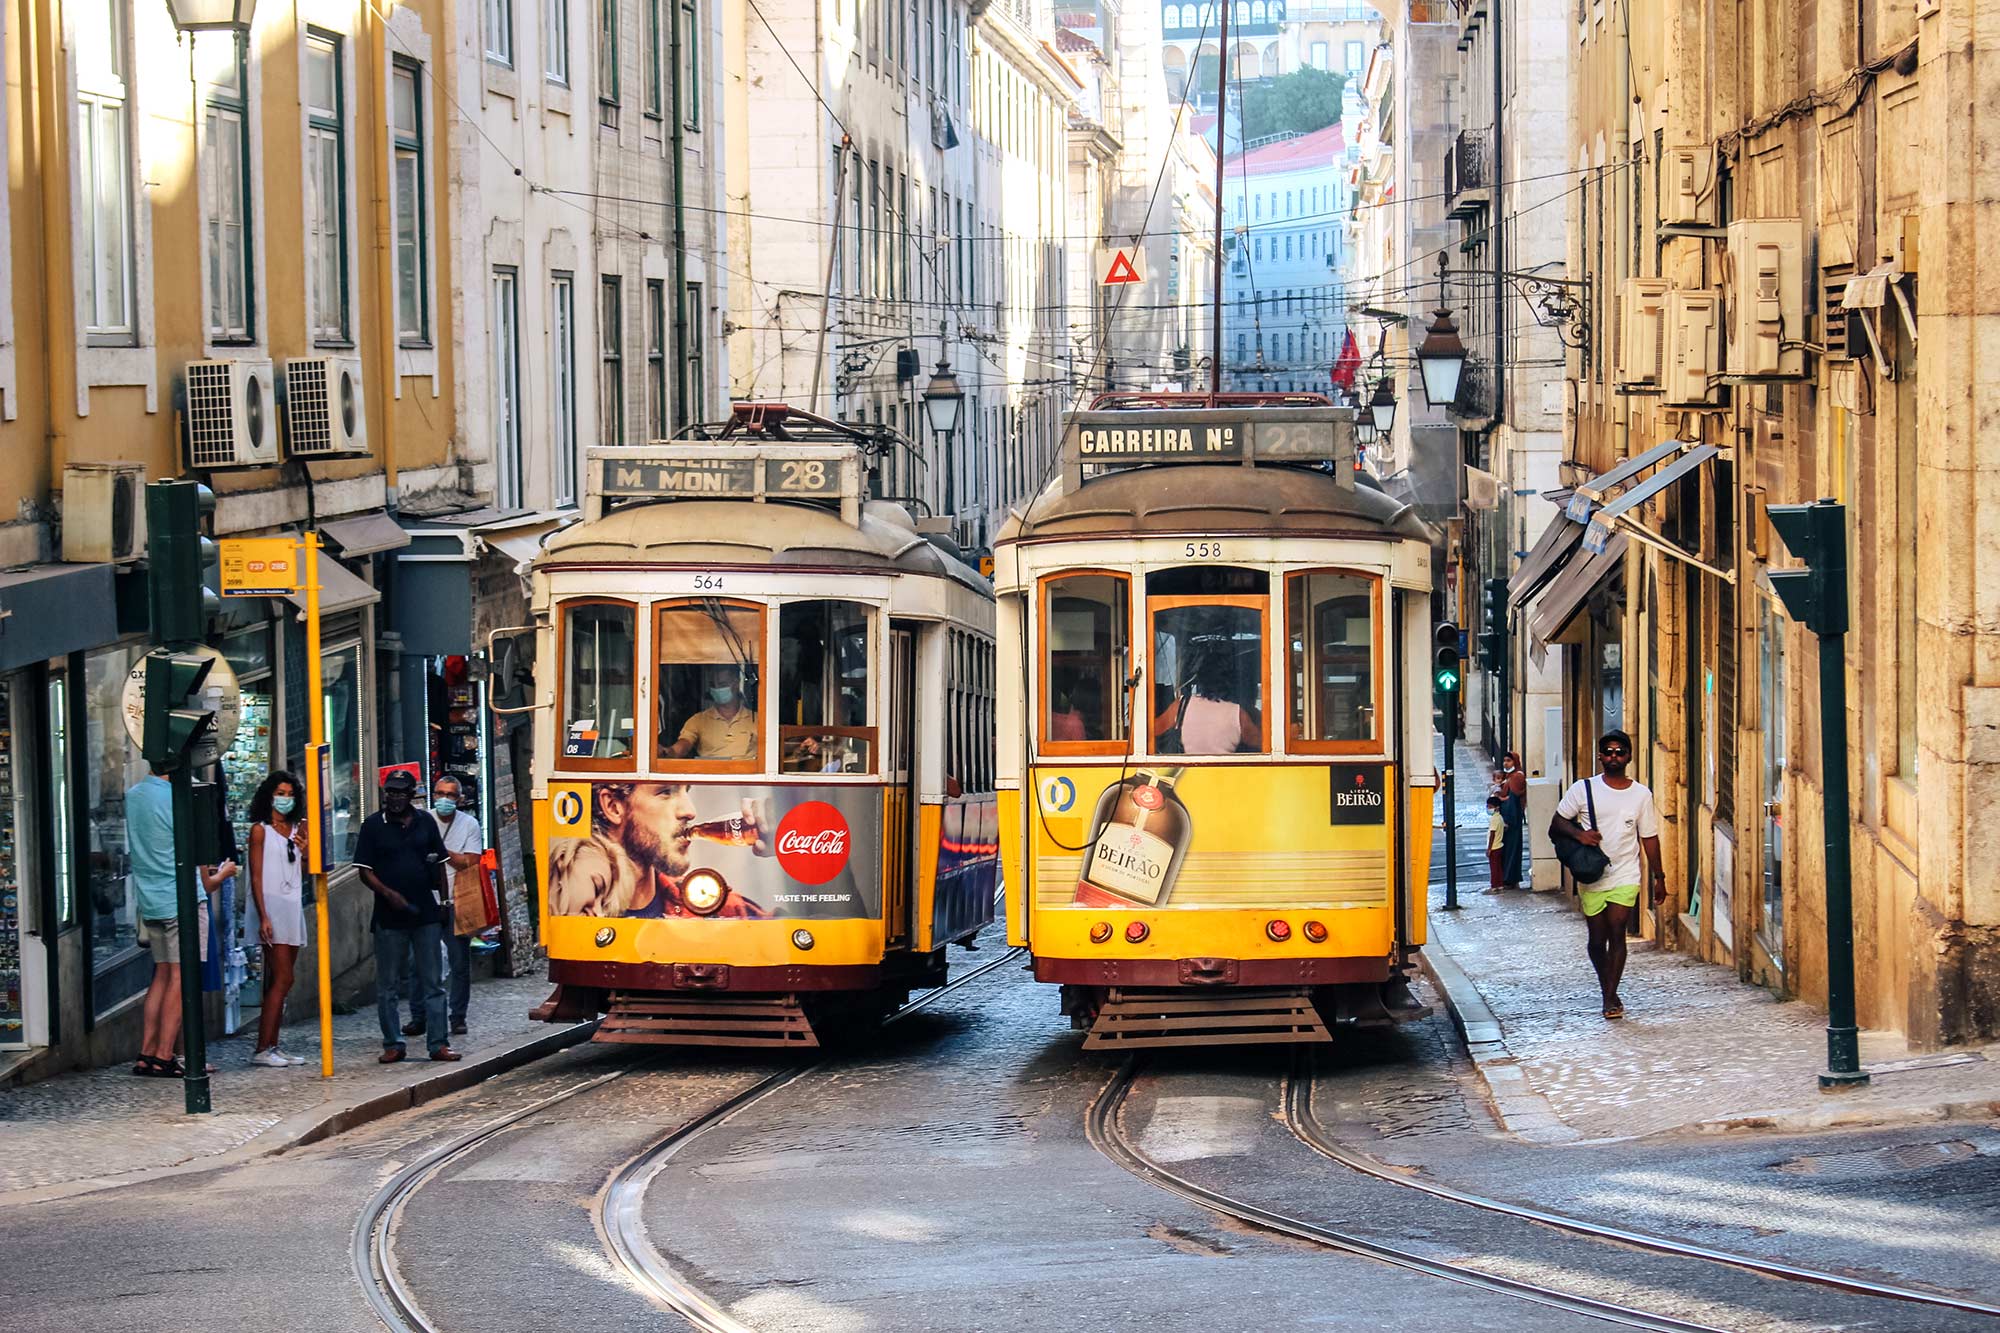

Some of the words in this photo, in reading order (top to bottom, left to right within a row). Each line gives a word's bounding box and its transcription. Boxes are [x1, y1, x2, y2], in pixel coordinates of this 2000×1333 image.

[1080, 428, 1193, 454] CARREIRA
[1207, 428, 1234, 452] Nº
[1264, 427, 1313, 454] 28
[616, 468, 644, 488] M.
[659, 470, 749, 492] MONIZ
[781, 461, 826, 489] 28
[1185, 542, 1221, 558] 558
[694, 575, 723, 589] 564
[567, 744, 579, 754] 08
[1336, 791, 1382, 807] BEIRÃO
[778, 829, 847, 855] Coca-Cola
[1098, 843, 1161, 879] BEIRÃO
[774, 894, 800, 902] TASTE
[801, 894, 818, 902] THE
[819, 894, 851, 902] FEELING
